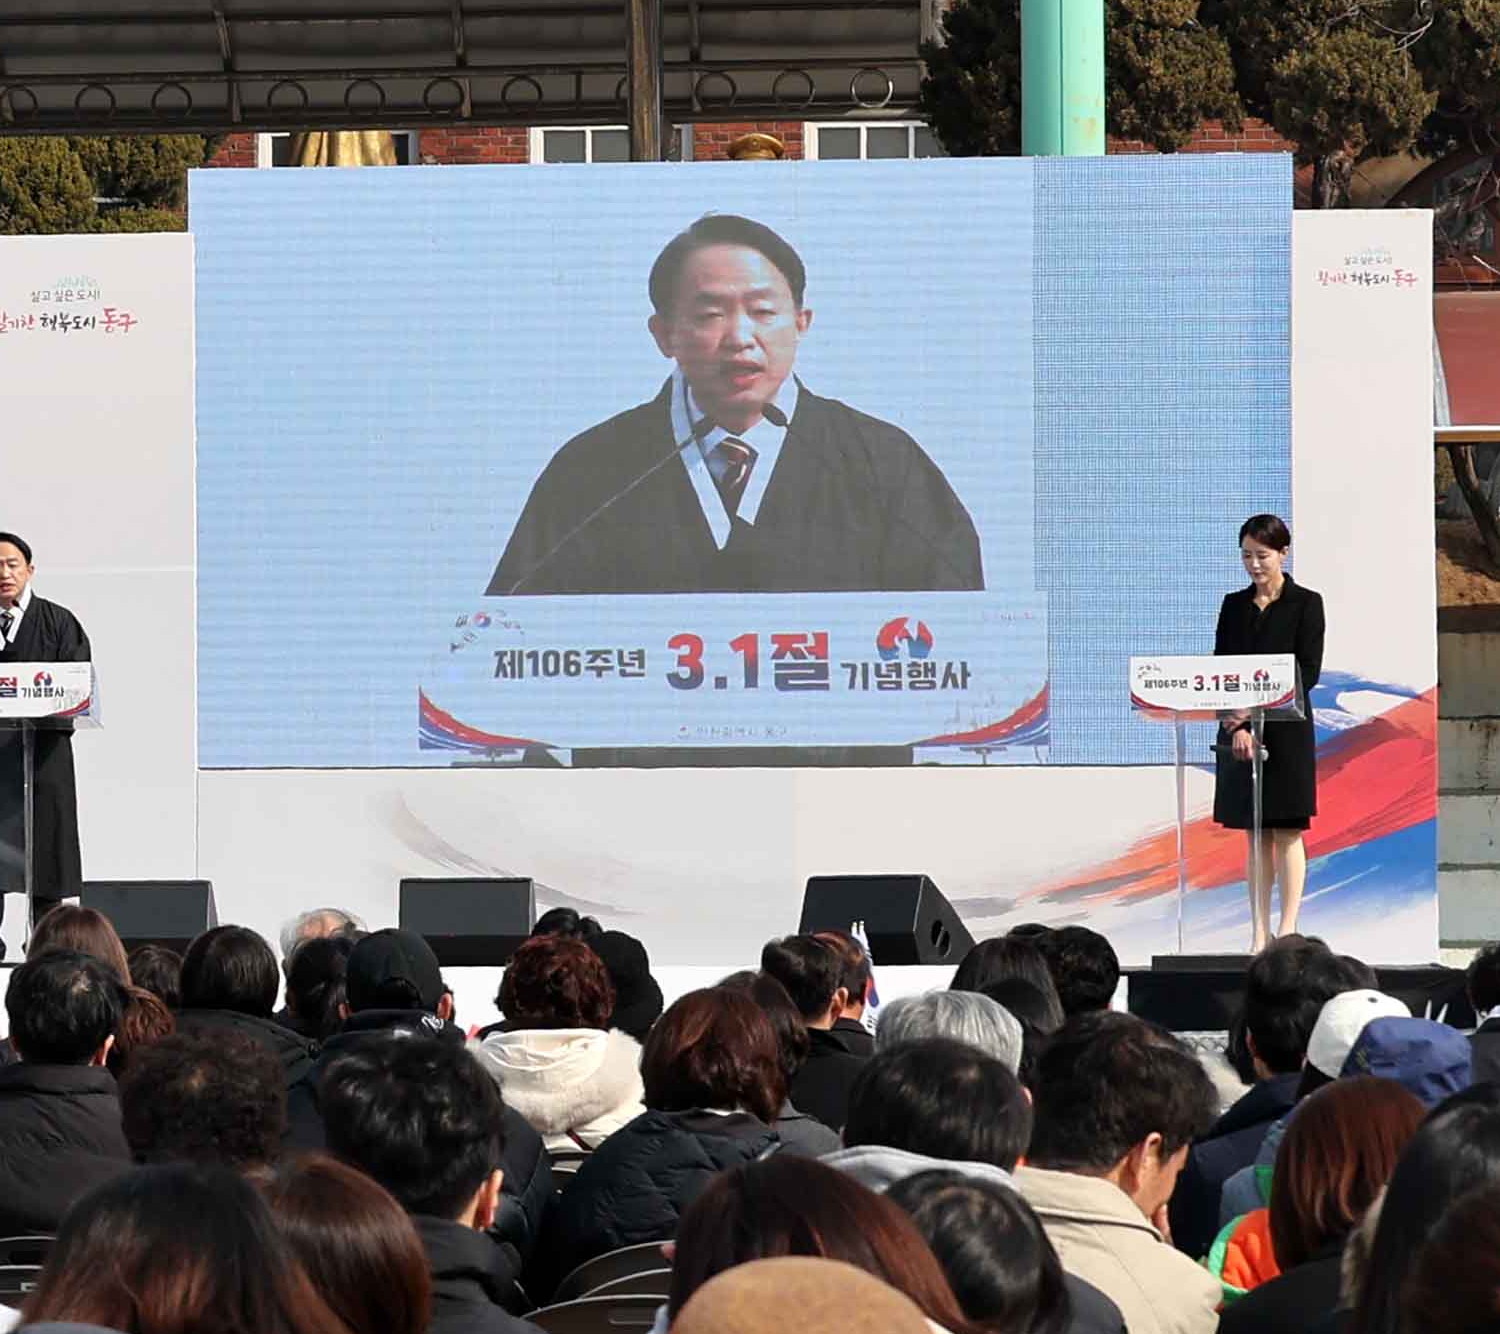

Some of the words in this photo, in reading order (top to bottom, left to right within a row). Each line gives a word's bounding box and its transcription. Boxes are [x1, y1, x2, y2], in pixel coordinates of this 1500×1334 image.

[39, 312, 96, 333] 행복도시
[99, 307, 138, 333] 동구
[494, 647, 646, 680] 제106주년
[666, 632, 831, 691] 3.1절
[840, 658, 972, 691] 기념행사
[1193, 674, 1240, 692] 3.1절
